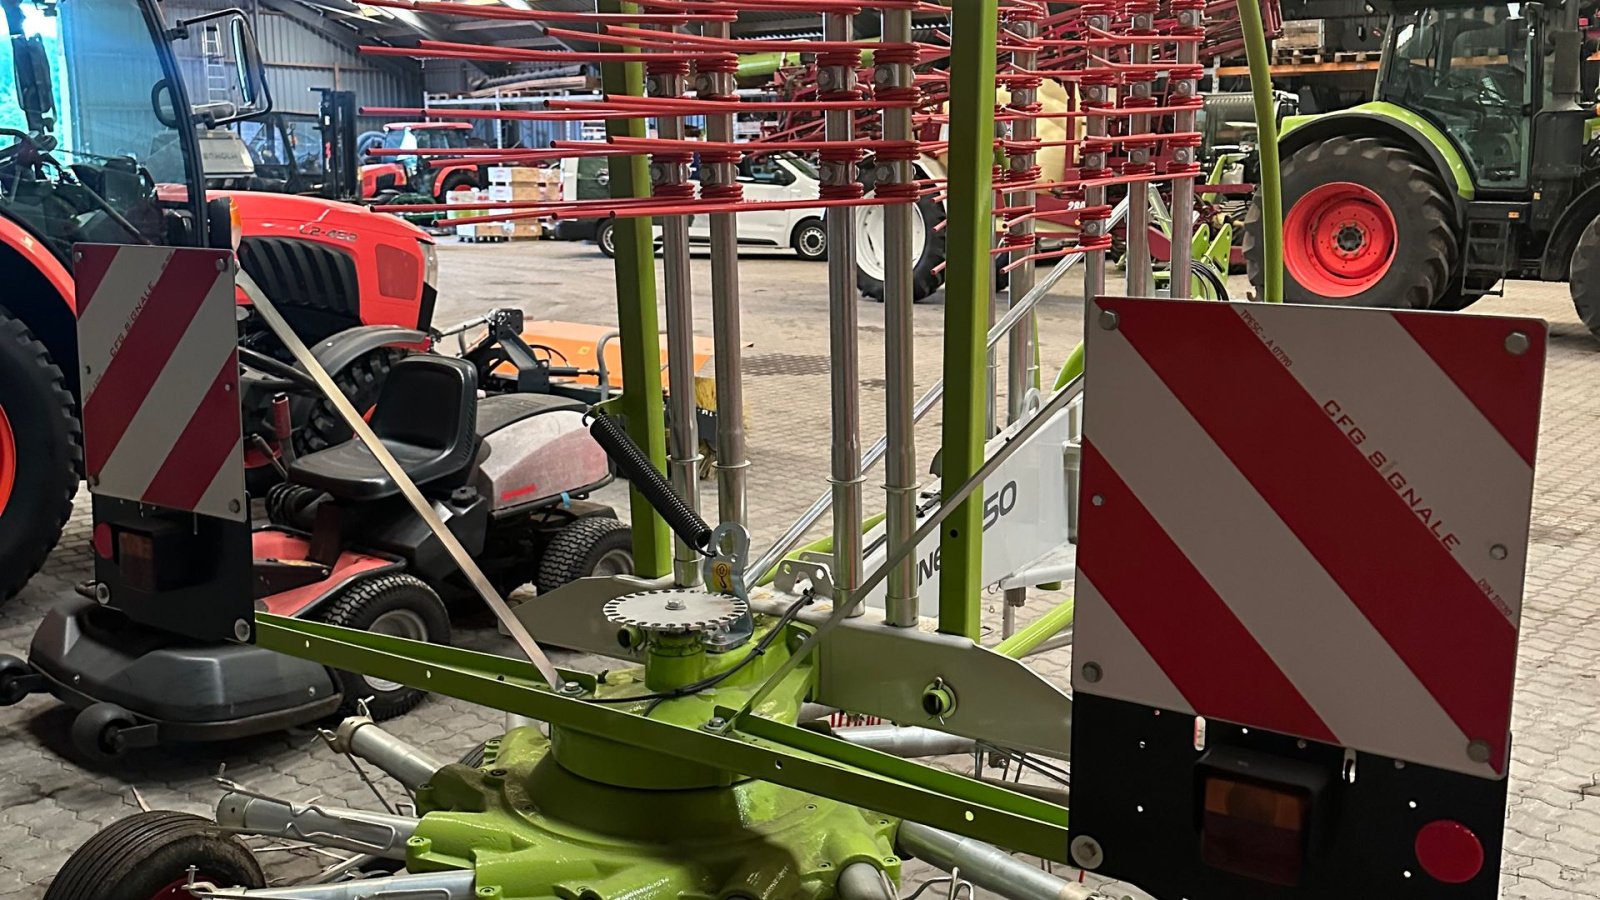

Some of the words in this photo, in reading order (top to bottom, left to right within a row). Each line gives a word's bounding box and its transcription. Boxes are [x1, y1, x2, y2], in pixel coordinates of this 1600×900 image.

[110, 332, 125, 358] CFG
[1323, 399, 1367, 445] CFG
[1368, 450, 1461, 552] SIGNALE
